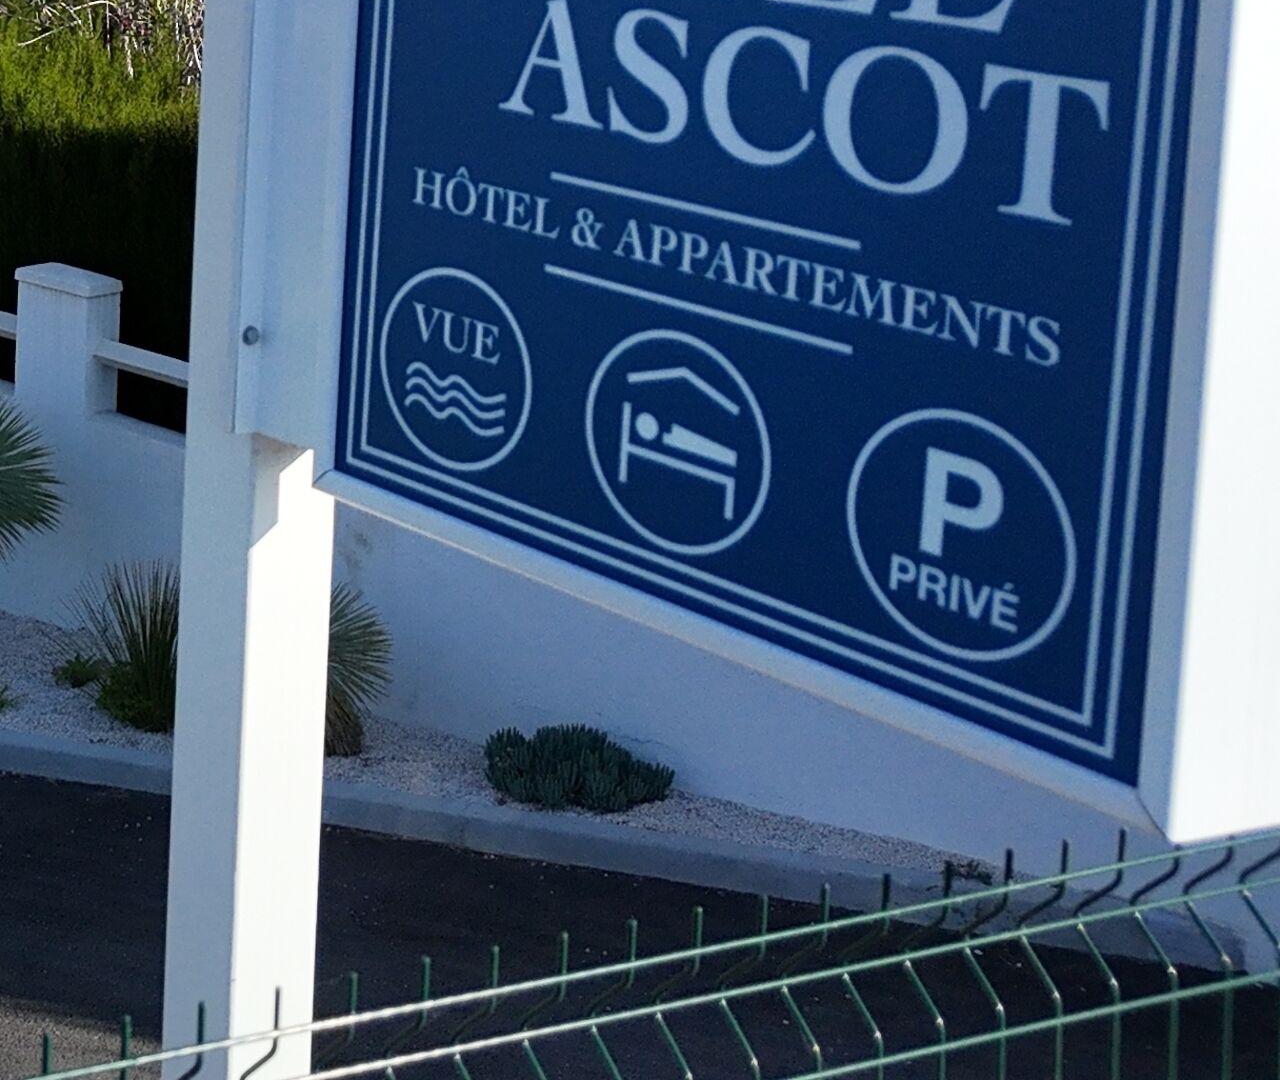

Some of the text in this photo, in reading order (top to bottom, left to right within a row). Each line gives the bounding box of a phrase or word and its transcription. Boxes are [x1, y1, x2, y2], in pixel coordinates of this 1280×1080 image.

[413, 167, 1061, 367] HÔTEL & APPARTEMENTS
[412, 302, 501, 366] VUE
[918, 447, 1004, 558] P
[889, 553, 1020, 634] PRIVÉ
